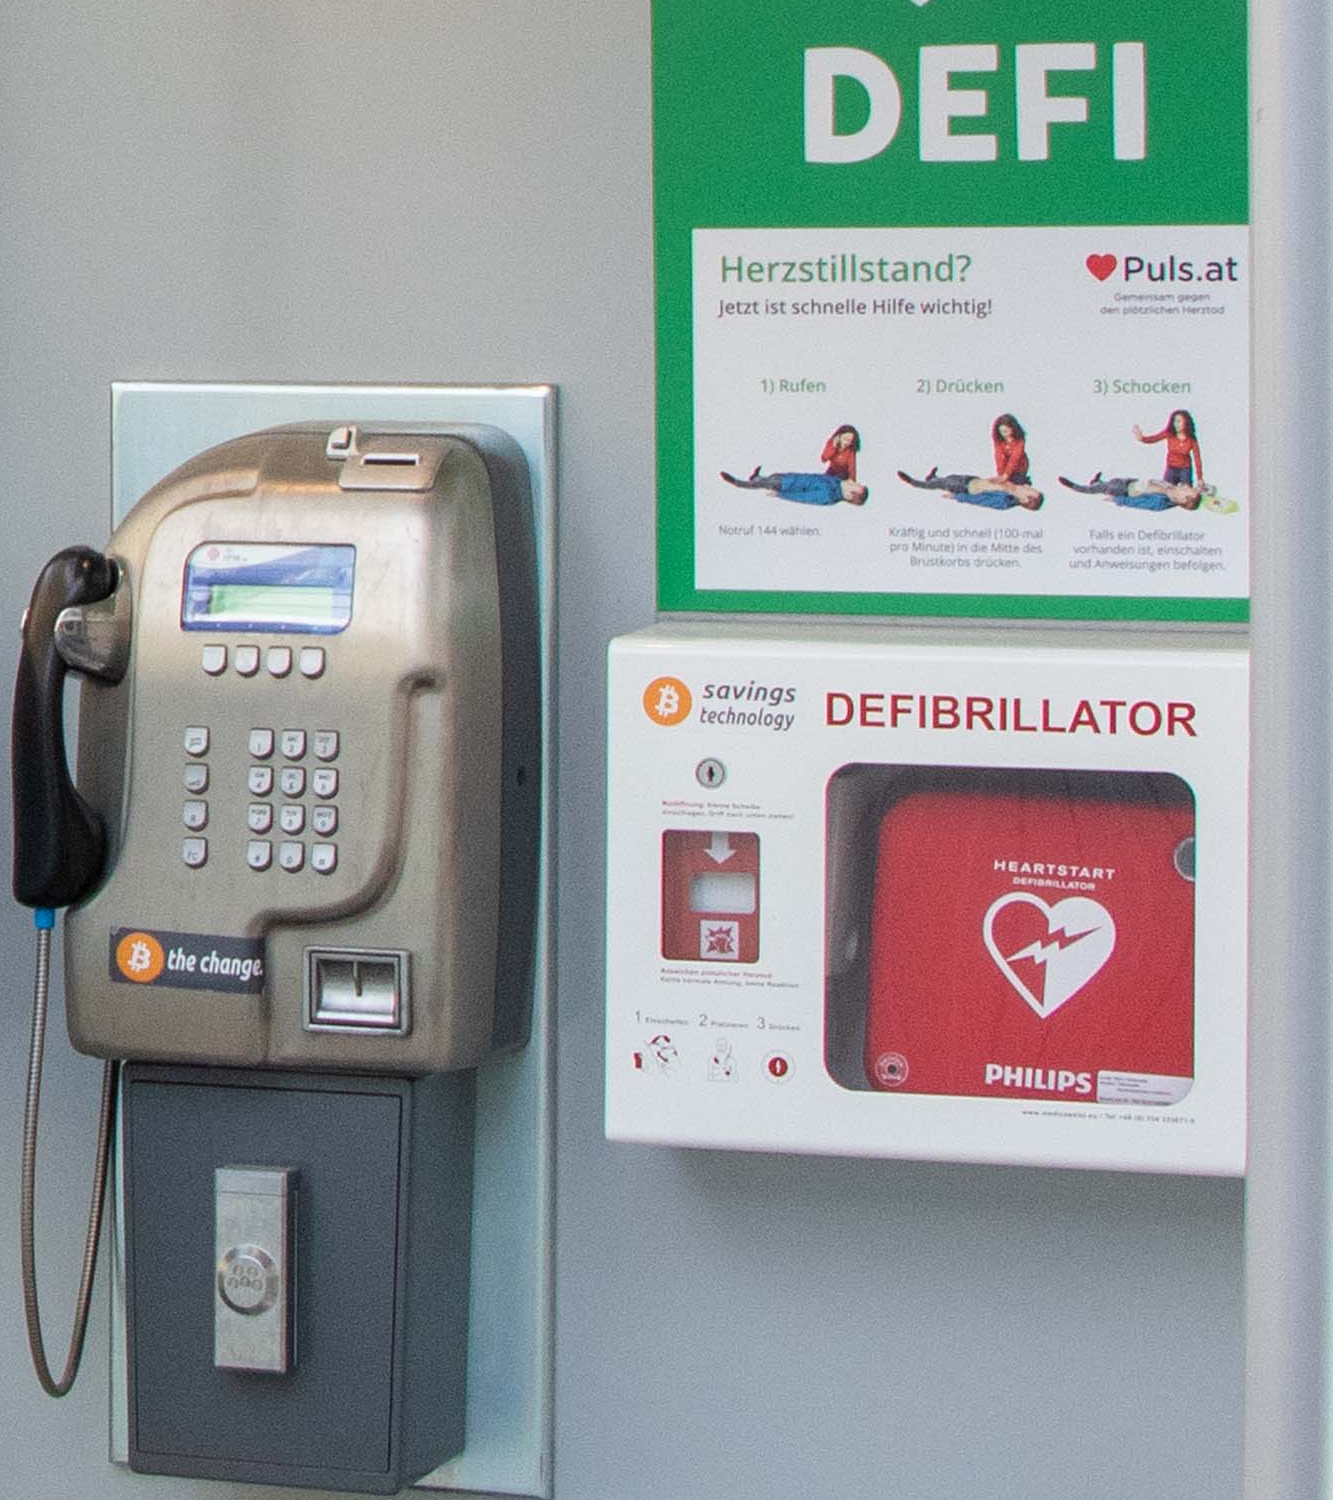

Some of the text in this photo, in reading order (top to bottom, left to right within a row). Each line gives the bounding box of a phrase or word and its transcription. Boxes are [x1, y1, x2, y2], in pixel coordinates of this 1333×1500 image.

[804, 41, 1147, 164] DEFI
[721, 254, 972, 284] Herzstillstand?
[1124, 255, 1239, 282] Puls.at
[1113, 293, 1210, 303] Gemeinsam gegen
[718, 299, 993, 319] Jetzt ist schnelle Hilfe wichtig!
[1100, 305, 1119, 315] den
[1183, 305, 1225, 315] Herztod
[761, 378, 826, 394] 1) Rufen
[917, 378, 1004, 394] 2) Drücken
[1094, 378, 1191, 395] 3) Schocken
[718, 525, 754, 536] Notruf
[757, 525, 777, 536] 144
[889, 527, 925, 539] Kräftig
[928, 528, 950, 538] und
[953, 527, 991, 538] schnell
[1089, 529, 1205, 541] Falls ein Defibrillator
[889, 542, 1043, 553] pro Minute) in die Mitte des
[1073, 545, 1134, 554] vorhanden
[1157, 545, 1222, 556] einschalten
[910, 556, 971, 567] Brustkorbs
[1069, 559, 1091, 569] und
[1094, 559, 1170, 572] Anweisungen
[703, 680, 796, 706] savings
[700, 706, 795, 731] technology
[825, 692, 1197, 737] DEFIBRILLATOR
[993, 859, 1115, 880] HEARTSTART
[1013, 876, 1096, 891] DEFIBRILLATOR
[167, 947, 264, 982] the change.
[699, 1013, 708, 1027] 2
[756, 1016, 766, 1030] 3
[985, 1063, 1092, 1094] PHILIPS
